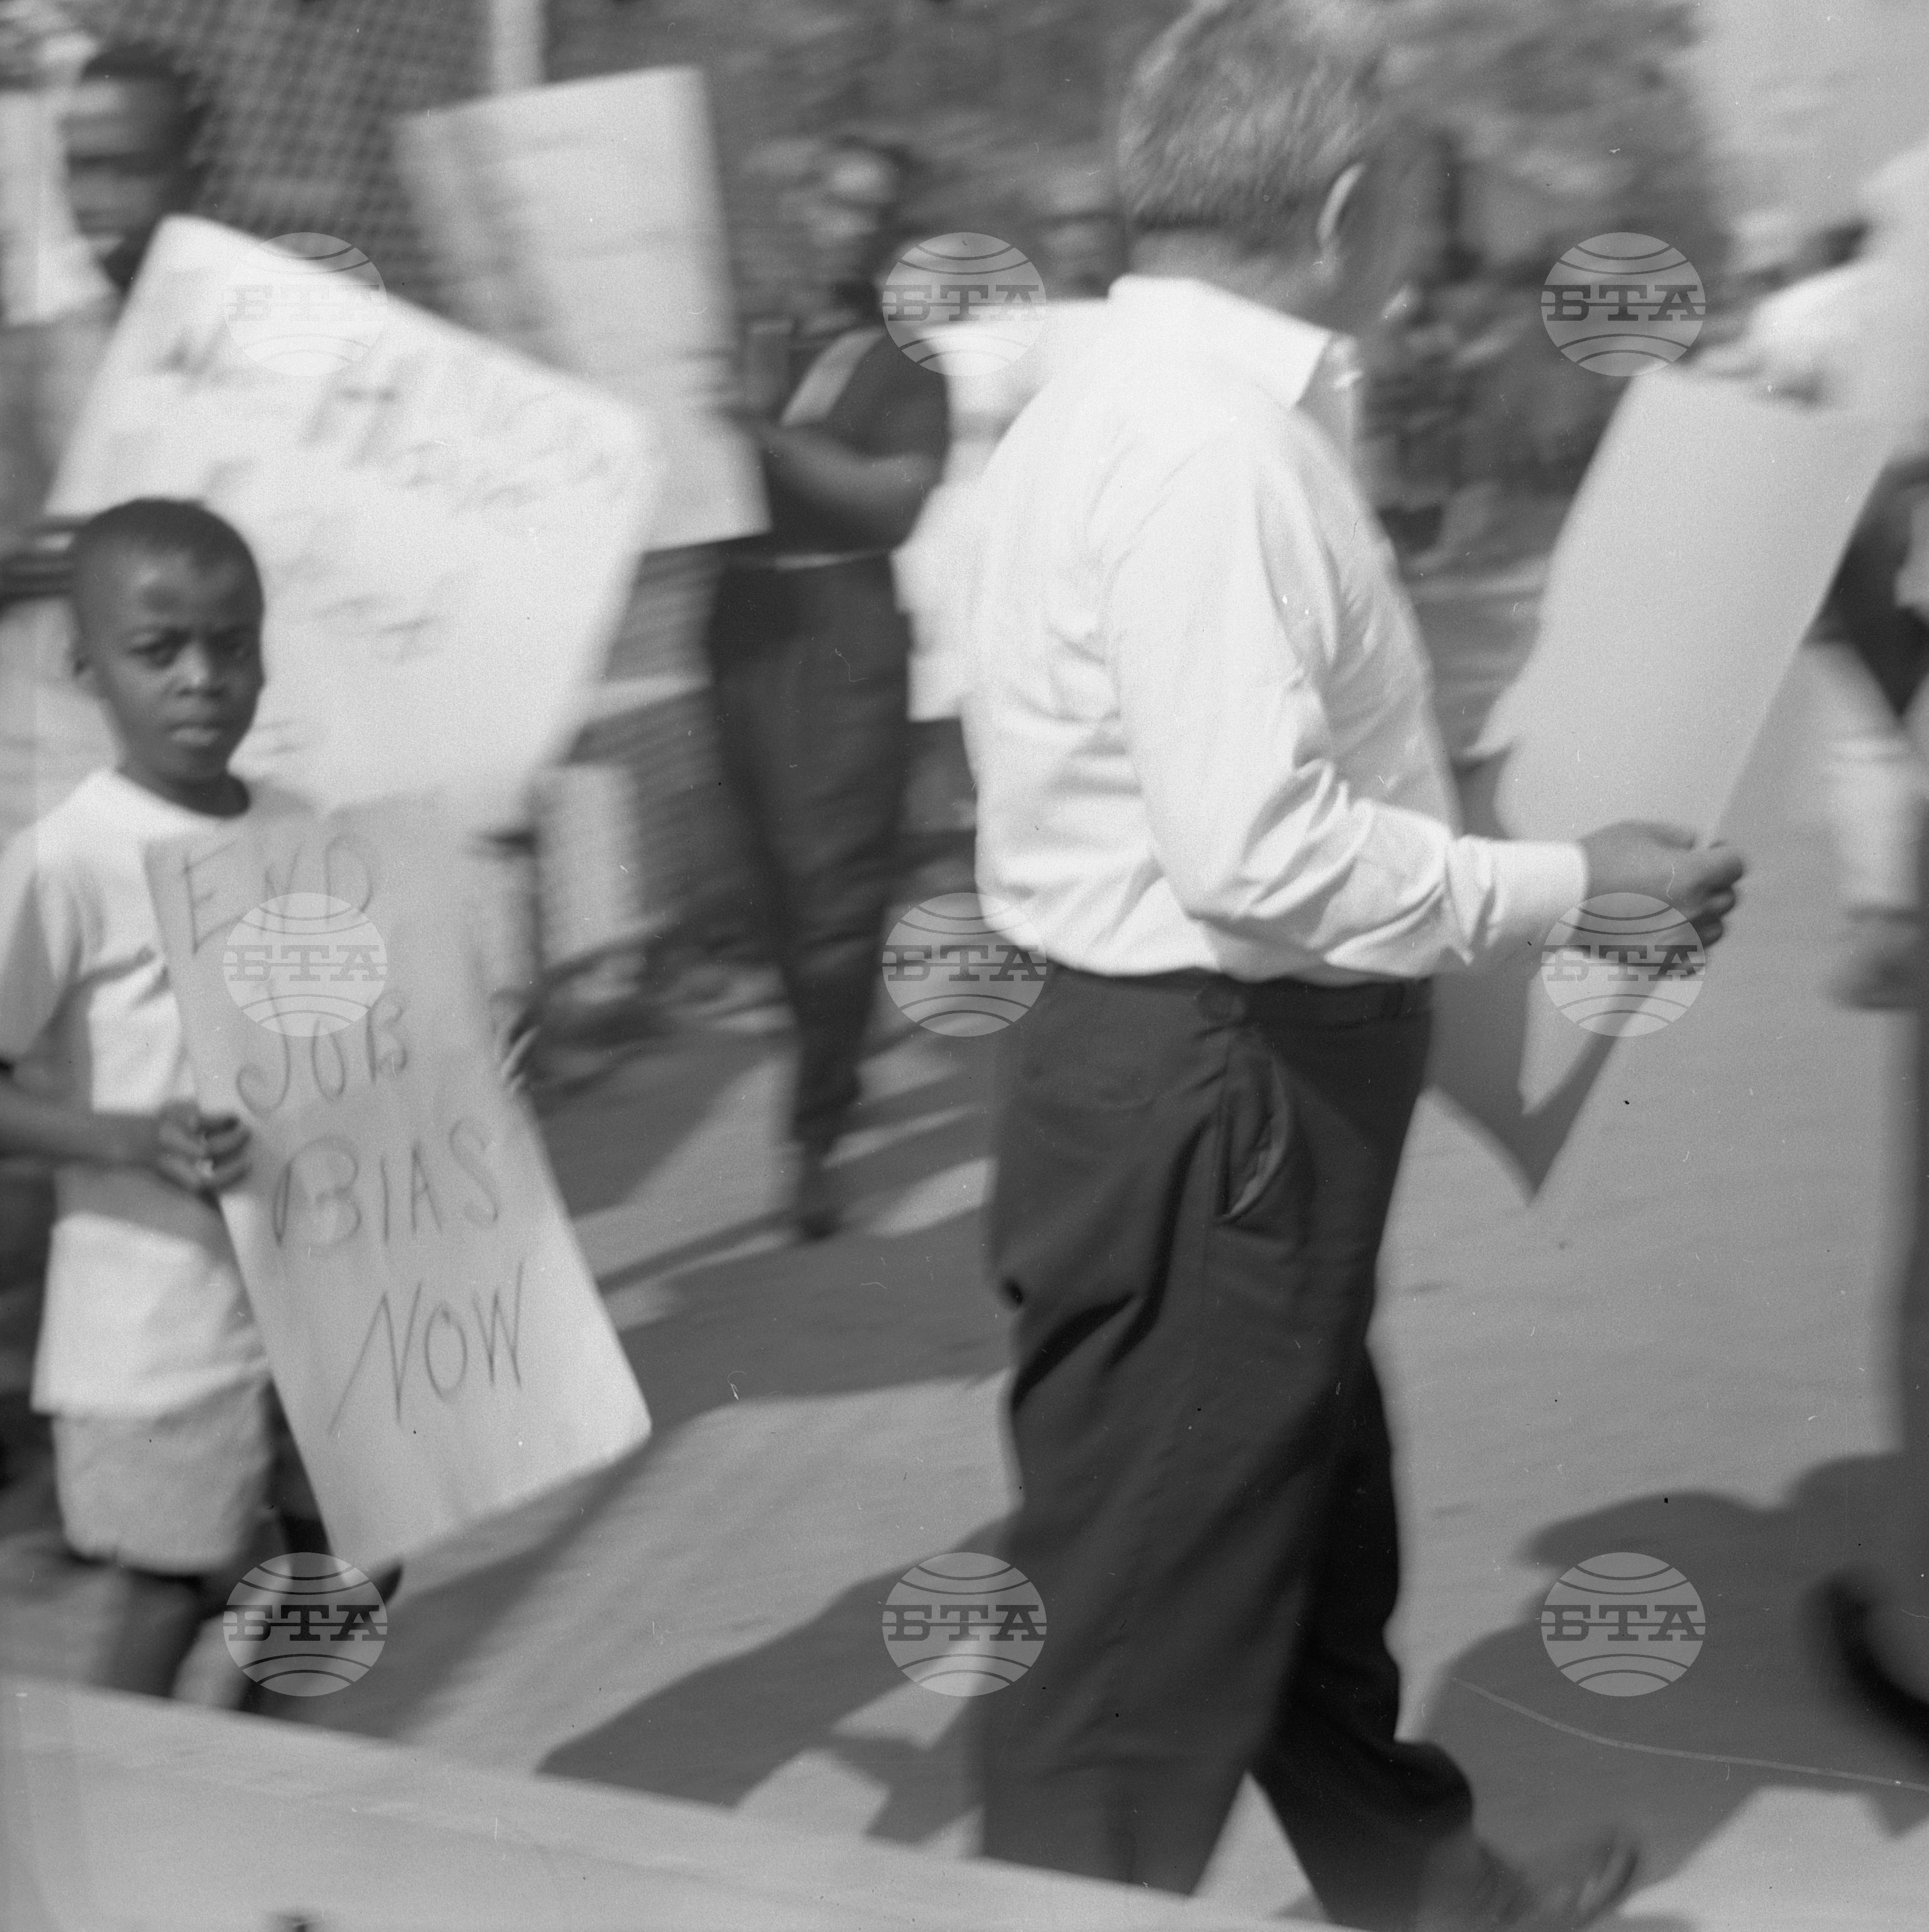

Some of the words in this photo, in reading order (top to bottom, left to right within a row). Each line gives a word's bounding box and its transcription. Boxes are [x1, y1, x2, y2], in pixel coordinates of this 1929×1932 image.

[183, 832, 376, 957] END
[235, 980, 410, 1118] JOB
[272, 1117, 500, 1247] BIAS
[326, 1261, 523, 1435] NOW
